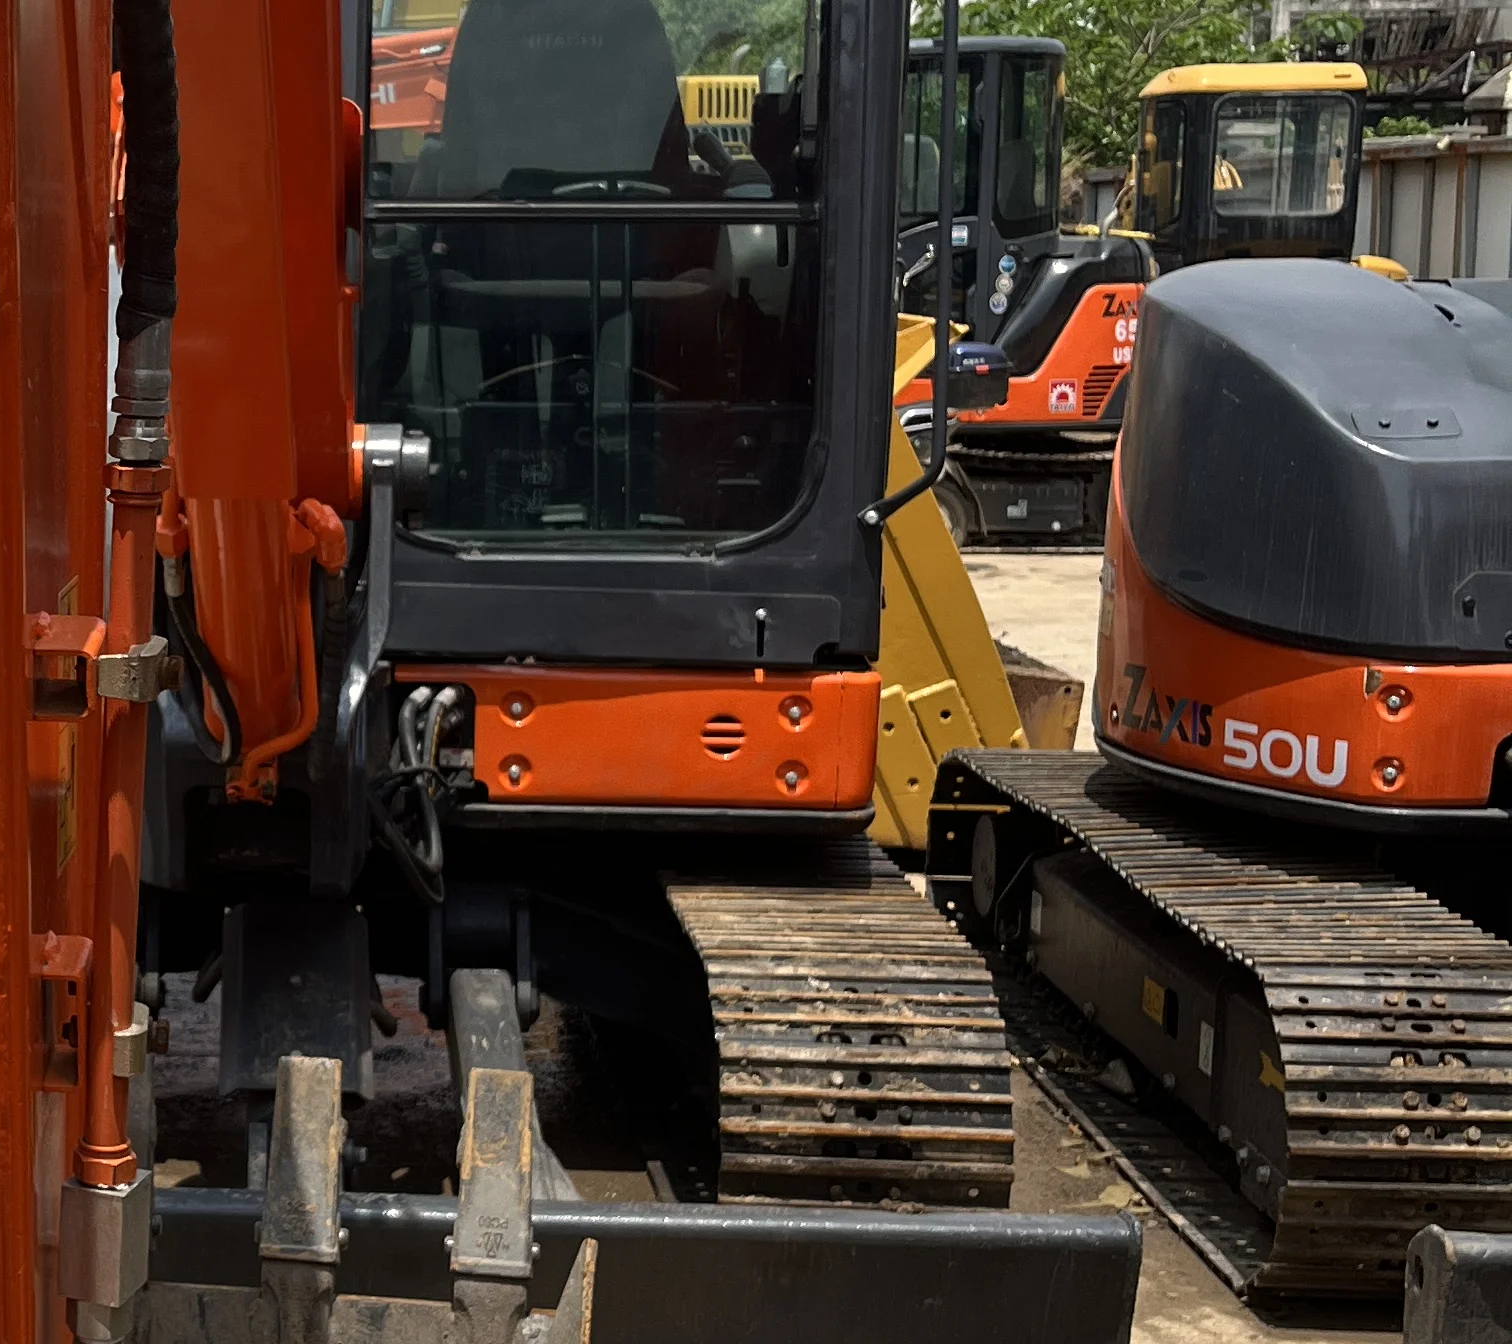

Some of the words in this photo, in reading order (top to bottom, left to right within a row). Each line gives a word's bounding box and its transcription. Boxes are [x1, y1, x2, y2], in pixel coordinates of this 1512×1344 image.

[1101, 292, 1138, 318] ZAX
[1112, 345, 1134, 365] US
[1121, 661, 1214, 747] ZAXIS
[1222, 717, 1350, 788] 50U
